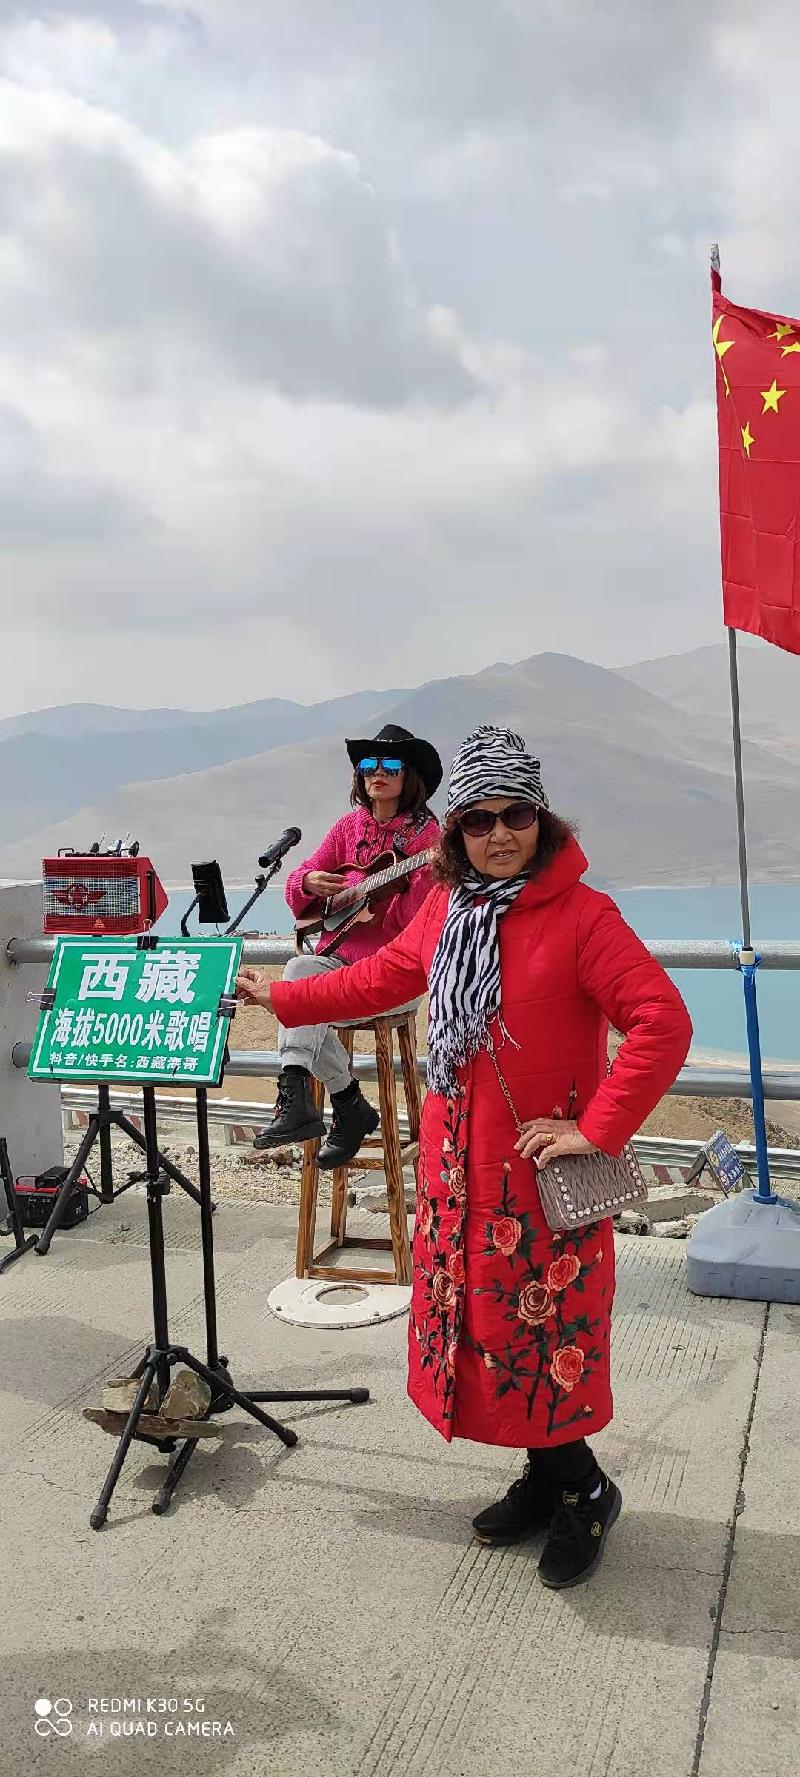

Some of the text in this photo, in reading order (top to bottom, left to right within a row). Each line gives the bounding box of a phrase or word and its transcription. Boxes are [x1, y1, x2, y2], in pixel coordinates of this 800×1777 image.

[78, 951, 202, 1004] 西藏
[50, 1008, 212, 1053] 海拔5000米歌唱
